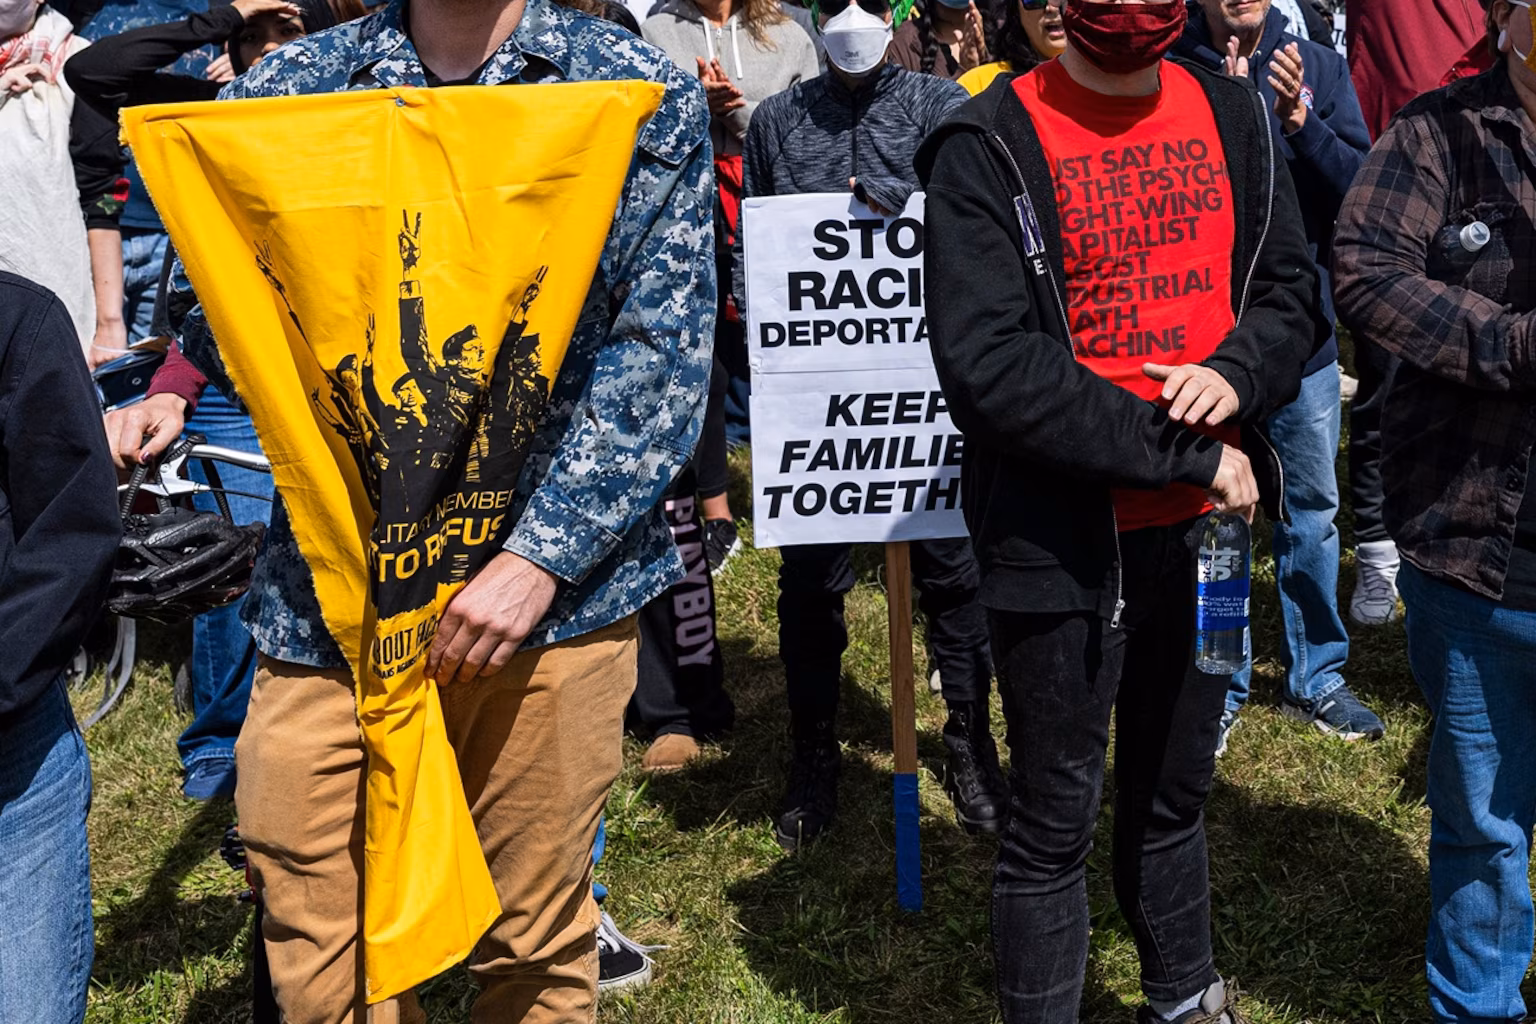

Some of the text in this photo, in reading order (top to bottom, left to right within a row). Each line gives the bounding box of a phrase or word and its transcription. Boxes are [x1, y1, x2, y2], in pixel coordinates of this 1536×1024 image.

[1101, 143, 1155, 174] SAY
[1163, 138, 1208, 164] NO
[1078, 173, 1133, 203] THE
[1062, 187, 1223, 235] GHT-WING
[812, 217, 924, 261] STO
[1061, 216, 1199, 260] APITALIST
[1074, 251, 1152, 283] SCIST
[788, 267, 926, 311] RACI
[760, 317, 930, 348] DEPORTA
[1073, 304, 1138, 333] ATH
[1073, 325, 1186, 358] ACHINE
[779, 433, 964, 474] FAMILIE
[763, 478, 963, 519] TOGETH
[378, 547, 420, 583] TO
